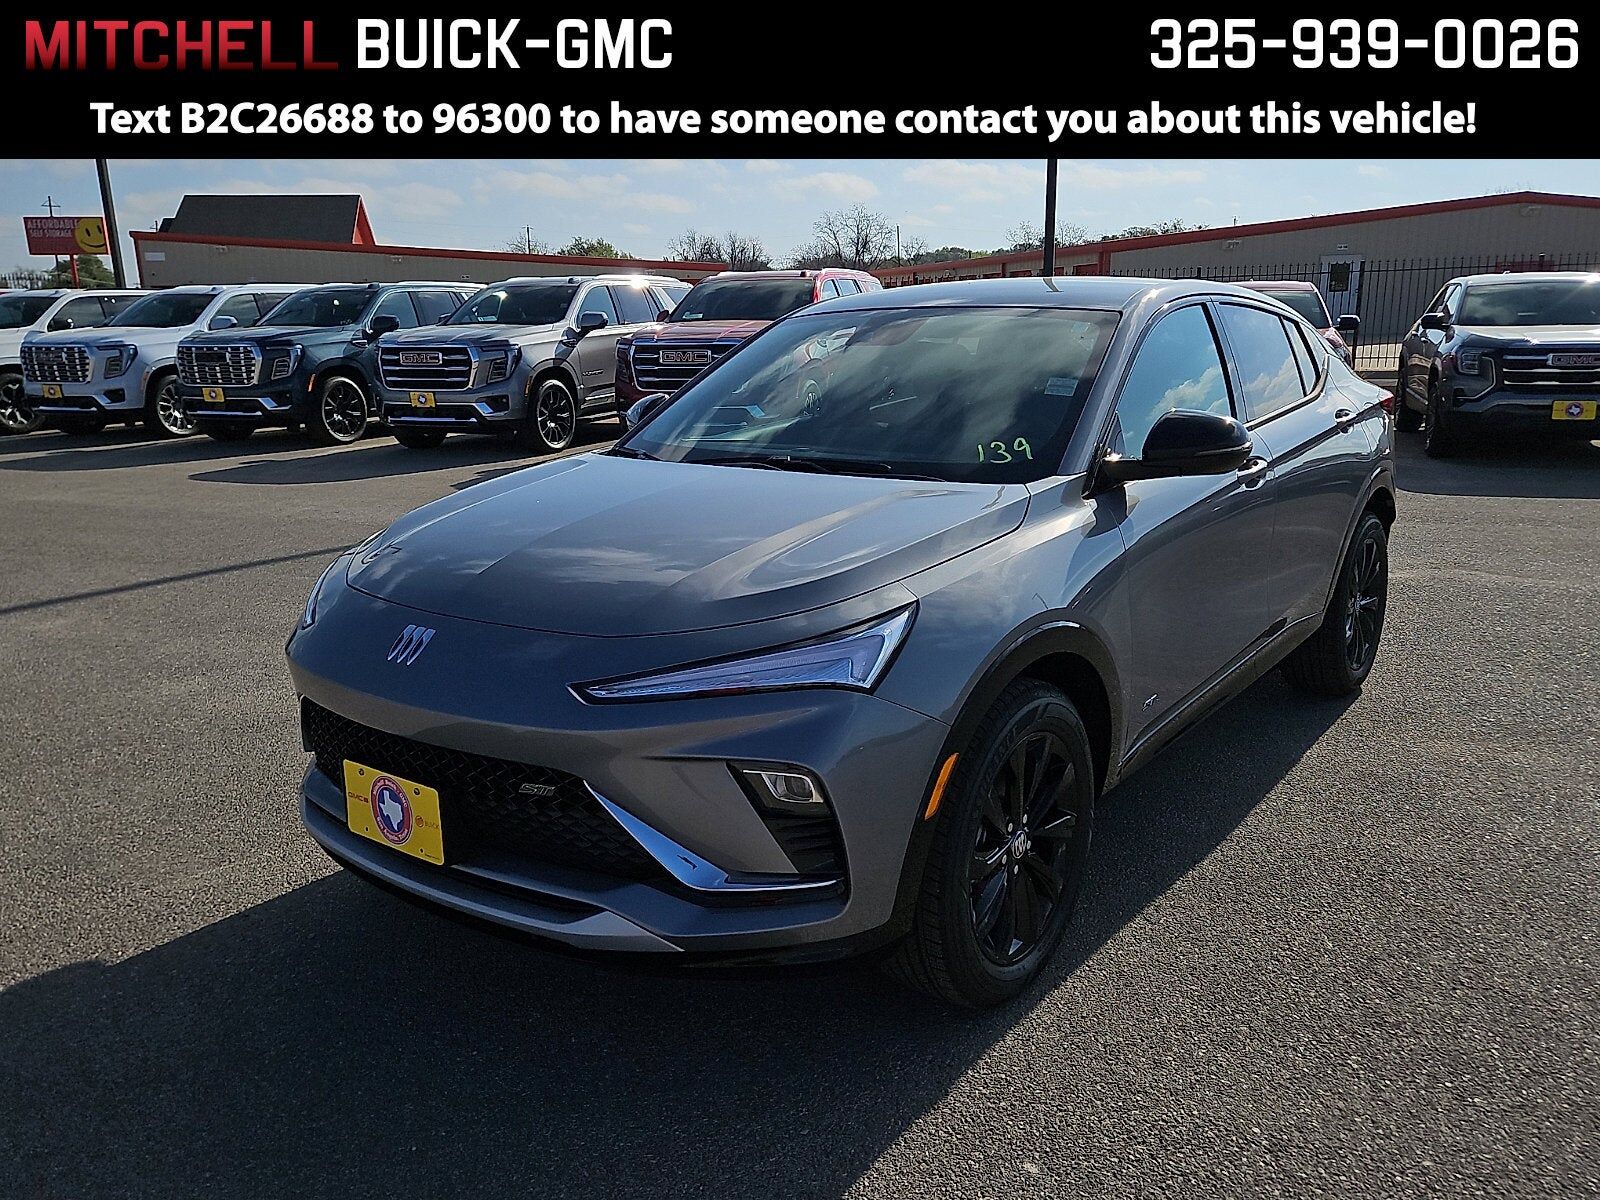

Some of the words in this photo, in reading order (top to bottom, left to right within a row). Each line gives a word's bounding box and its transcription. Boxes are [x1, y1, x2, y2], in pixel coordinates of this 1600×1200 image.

[402, 353, 440, 363] GMC
[662, 351, 708, 362] GMC
[977, 437, 1033, 464] 139
